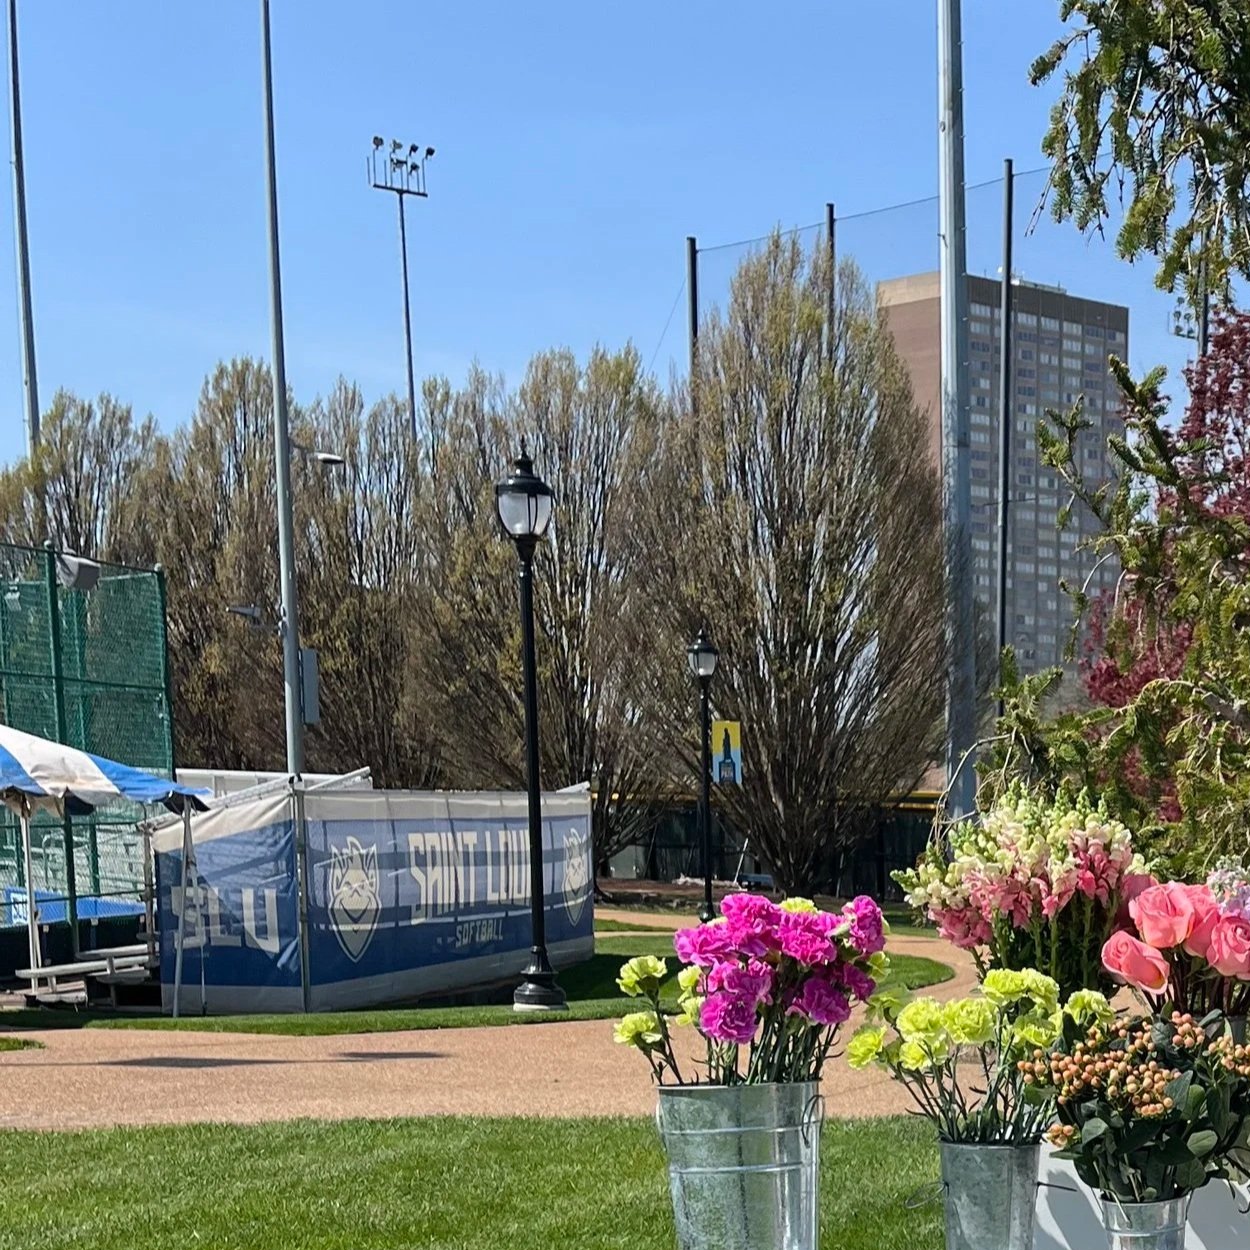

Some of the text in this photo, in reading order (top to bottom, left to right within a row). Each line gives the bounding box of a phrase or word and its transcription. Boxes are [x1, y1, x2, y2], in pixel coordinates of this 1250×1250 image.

[407, 829, 532, 926] SAINT LOUI
[170, 886, 280, 954] SLU
[455, 918, 504, 949] SOFTBALL
